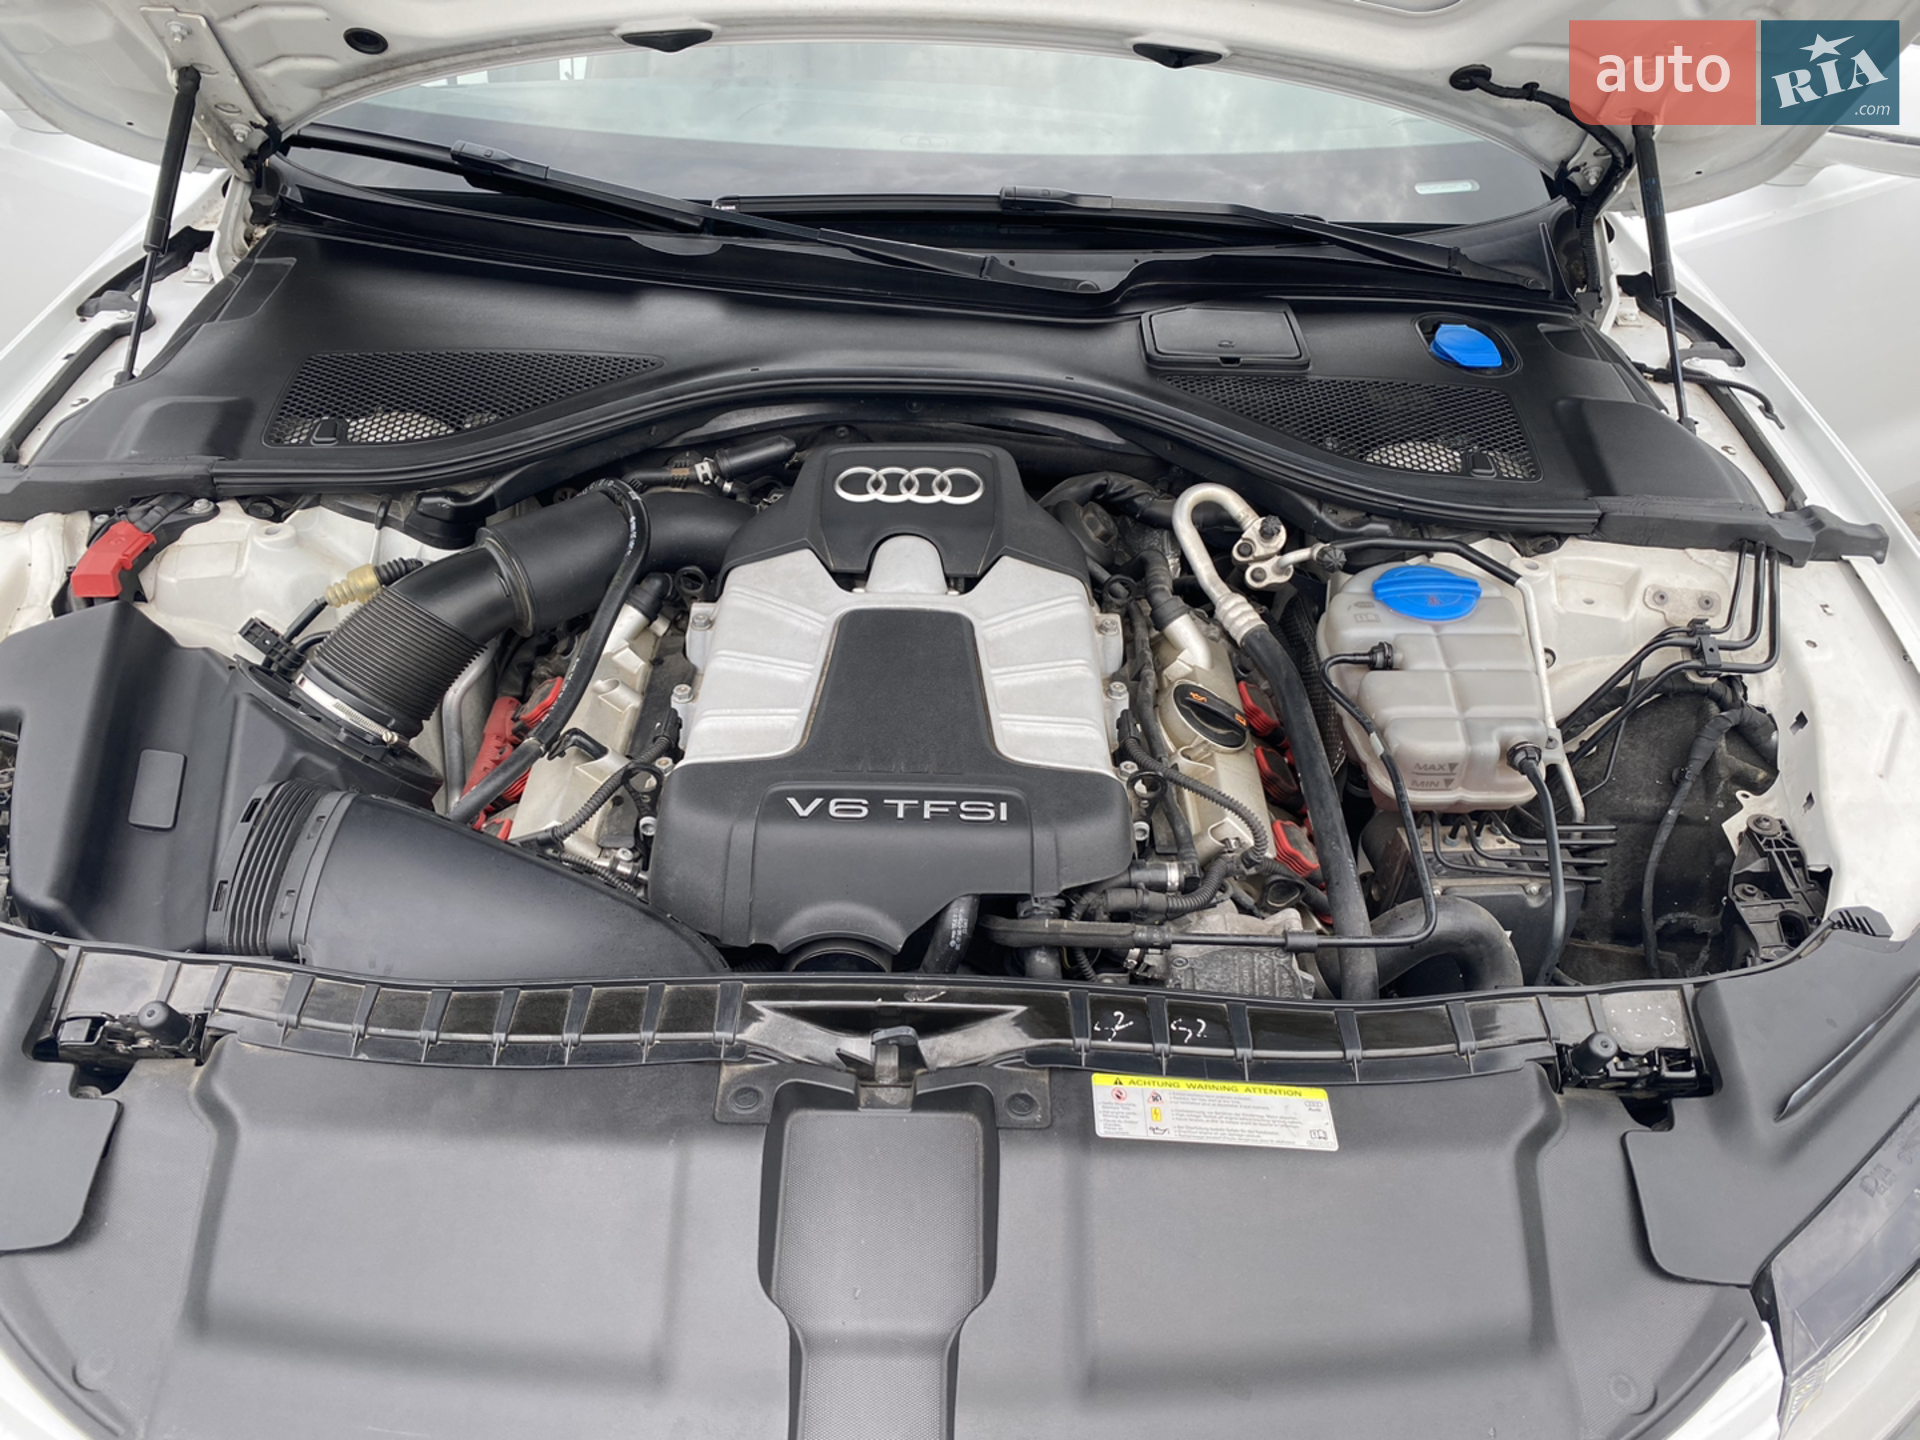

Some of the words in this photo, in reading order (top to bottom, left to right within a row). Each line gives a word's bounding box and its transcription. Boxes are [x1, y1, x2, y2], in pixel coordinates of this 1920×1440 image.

[1414, 763, 1447, 771] MAX
[1411, 780, 1440, 788] MIN
[786, 797, 869, 819] V6
[883, 799, 1008, 822] TFSI
[1128, 1079, 1181, 1088] ACHTUNG
[1185, 1082, 1239, 1093] WARNING
[1244, 1086, 1303, 1097] ATTENTION
